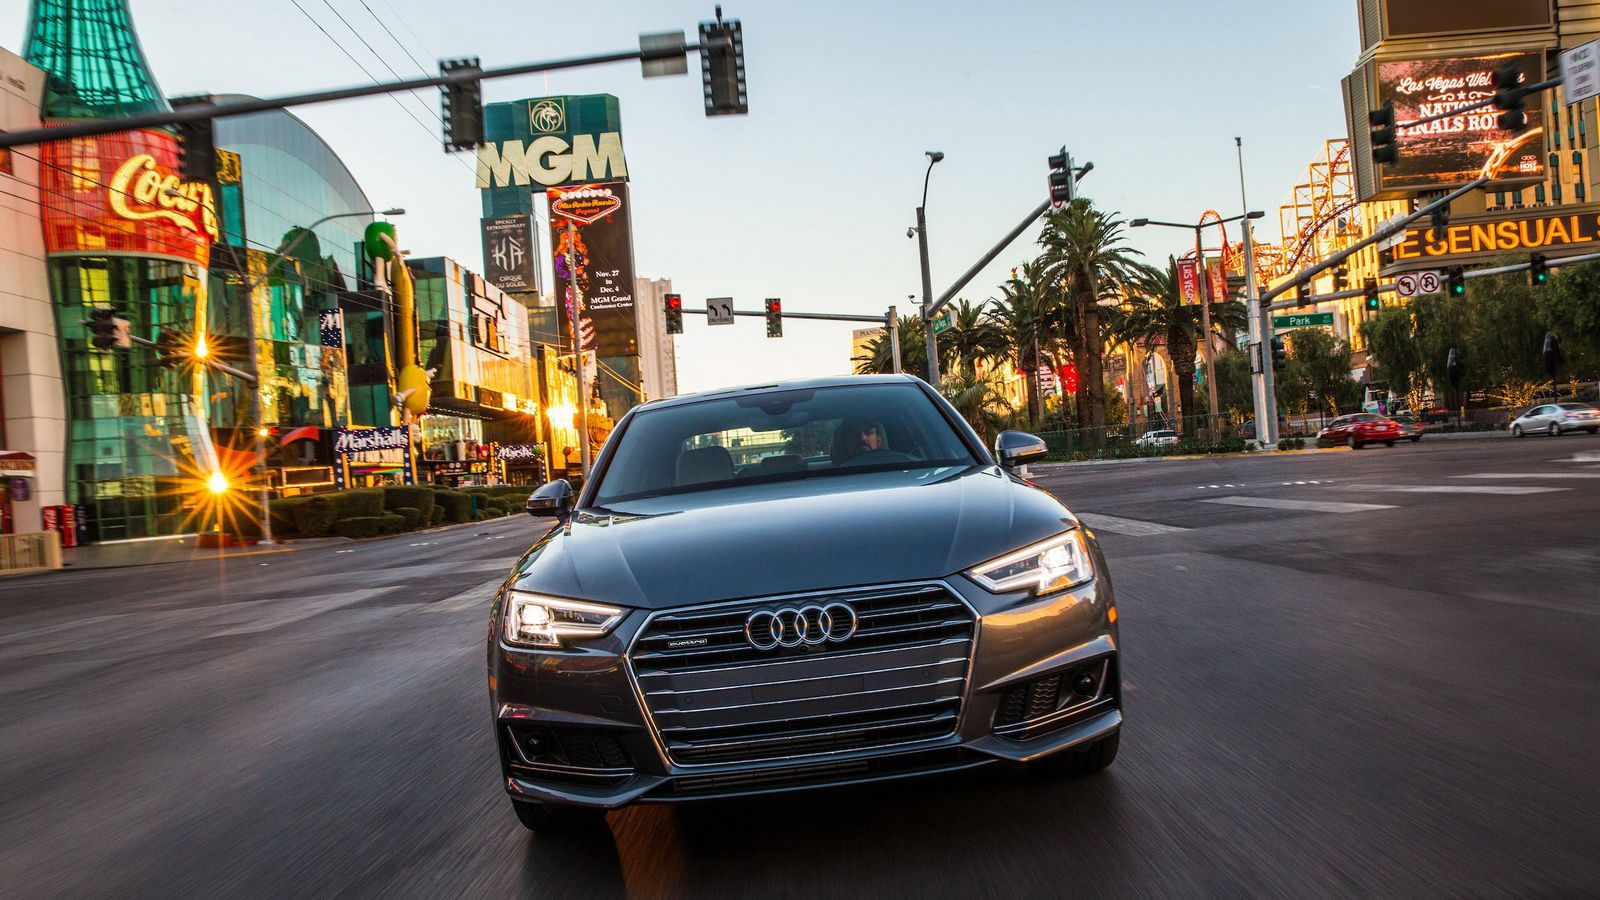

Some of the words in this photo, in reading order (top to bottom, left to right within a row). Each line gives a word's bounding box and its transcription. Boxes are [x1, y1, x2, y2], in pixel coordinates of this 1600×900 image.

[1396, 77, 1424, 94] Las
[1425, 76, 1465, 93] Vegas
[475, 132, 628, 189] MGM
[1424, 215, 1593, 257] SENSUAL
[499, 274, 523, 282] CIRQUE
[1182, 264, 1193, 279] LAS
[1184, 280, 1195, 304] VEGAS
[322, 313, 341, 330] M
[1289, 316, 1311, 326] Park
[335, 429, 409, 451] Marshalls
